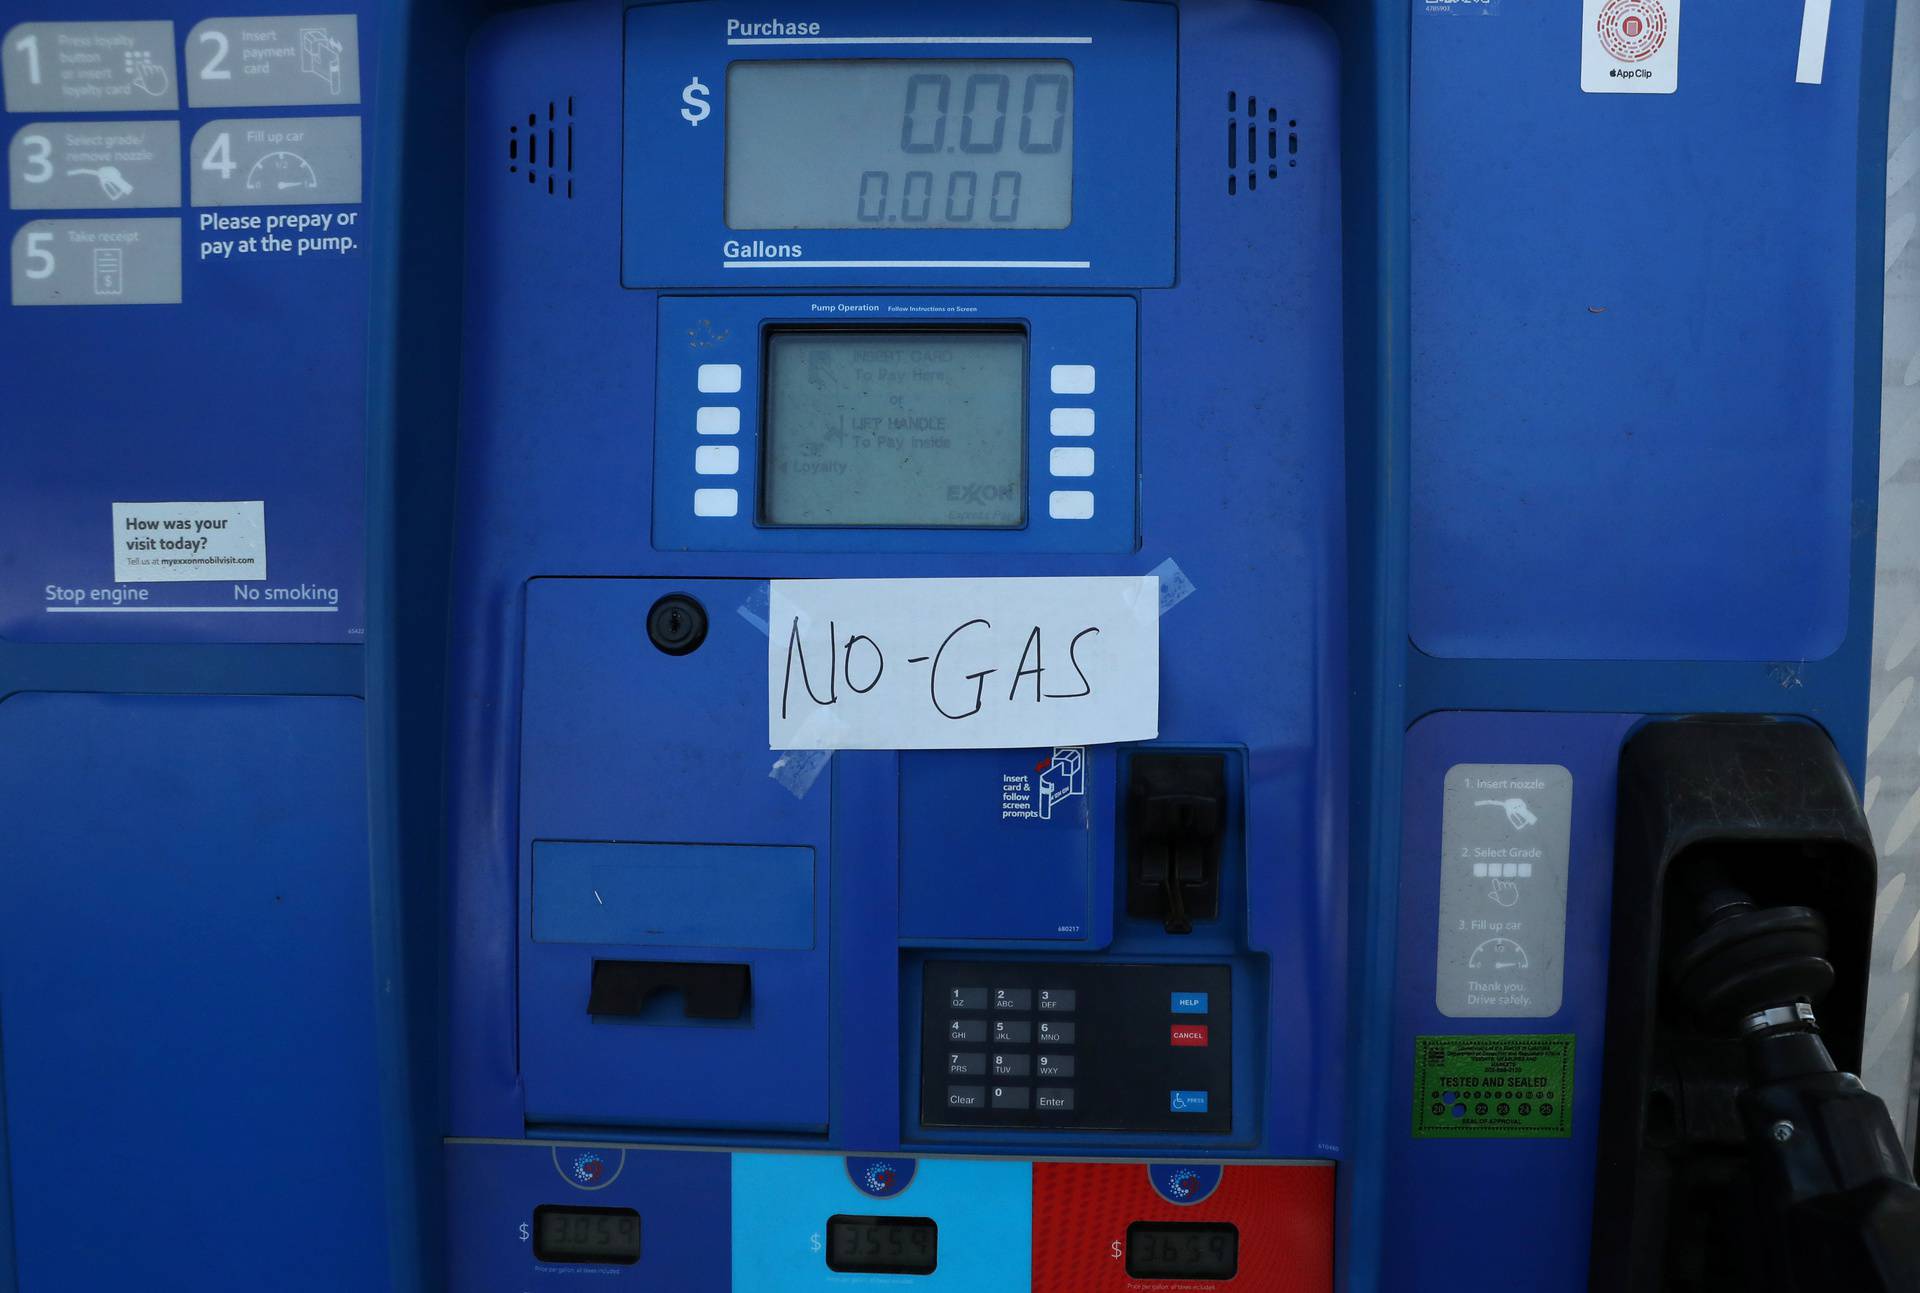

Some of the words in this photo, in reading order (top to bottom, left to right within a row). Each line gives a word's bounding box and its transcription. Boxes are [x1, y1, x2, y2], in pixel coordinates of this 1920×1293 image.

[727, 19, 820, 36] Purchase
[242, 31, 277, 41] Insert
[59, 52, 101, 64] button
[200, 31, 231, 80] 2
[243, 47, 296, 59] payment
[16, 35, 41, 84] 1
[244, 61, 270, 74] card
[1617, 69, 1634, 78] App
[1635, 69, 1652, 79] Clip
[681, 77, 711, 125] $
[900, 74, 1069, 154] 0.00
[65, 133, 103, 147] Select
[247, 131, 264, 142] Fill
[267, 133, 283, 144] up
[286, 132, 304, 142] car
[22, 135, 54, 183] 3
[202, 132, 236, 179] 4
[857, 171, 1022, 222] 0.000
[200, 212, 261, 230] Please
[266, 213, 333, 233] prepay
[337, 212, 358, 226] or
[68, 230, 96, 241] Take
[98, 231, 140, 243] receipt
[201, 240, 234, 260] pay
[238, 237, 257, 253] at
[261, 234, 293, 251] the
[298, 236, 358, 255] pump.
[723, 241, 802, 259] Gallons
[25, 233, 55, 279] 5
[811, 304, 836, 312] Pump
[837, 303, 880, 312] Operation
[887, 416, 945, 431] HANDLE
[853, 435, 871, 448] To
[877, 435, 903, 451] Pay
[794, 460, 848, 475] Loyalty
[126, 517, 160, 530] How
[163, 519, 192, 529] was
[195, 519, 228, 533] your
[126, 537, 157, 550] visit
[160, 536, 208, 553] today?
[127, 557, 140, 565] Tell
[161, 556, 255, 567] myexxonmobilvisit.com
[45, 585, 86, 604] Stop
[90, 587, 149, 605] engine
[234, 585, 260, 601] No
[264, 583, 339, 604] smoking
[1003, 774, 1028, 782] Insert
[1464, 778, 1475, 789] 1.
[1476, 778, 1508, 789] Insert
[1510, 779, 1545, 790] nozzle
[1003, 783, 1022, 791] card
[1023, 783, 1031, 791] &
[1003, 792, 1030, 801] follow
[1002, 810, 1039, 819] prompts
[1462, 847, 1472, 857] 2.
[1474, 847, 1507, 858] Select
[1509, 847, 1543, 858] Grade
[1471, 919, 1487, 930] Fill
[1489, 922, 1503, 933] up
[1506, 922, 1522, 930] car
[1468, 981, 1501, 991] Thank
[953, 989, 960, 998] 1
[997, 990, 1006, 999] 2
[1042, 991, 1049, 1000] 3
[1467, 994, 1497, 1005] Drive
[952, 999, 965, 1007] QZ
[997, 1000, 1014, 1008] ABC
[952, 1021, 960, 1030] 4
[996, 1022, 1004, 1031] 5
[1041, 1023, 1049, 1032] 6
[951, 1054, 959, 1063] 7
[995, 1056, 1003, 1065] 8
[1040, 1056, 1048, 1066] 9
[951, 1065, 967, 1073] PRS
[995, 1066, 1012, 1074] TUV
[1040, 1067, 1059, 1075] WXY
[1440, 1077, 1480, 1088] TESTED
[1482, 1077, 1506, 1088] AND
[1507, 1076, 1548, 1088] SEALED
[994, 1087, 1003, 1097] 0
[950, 1095, 976, 1105] Clear
[1039, 1097, 1065, 1106] Enter
[519, 1221, 529, 1241] $
[811, 1233, 822, 1252] $
[1111, 1240, 1122, 1259] $
